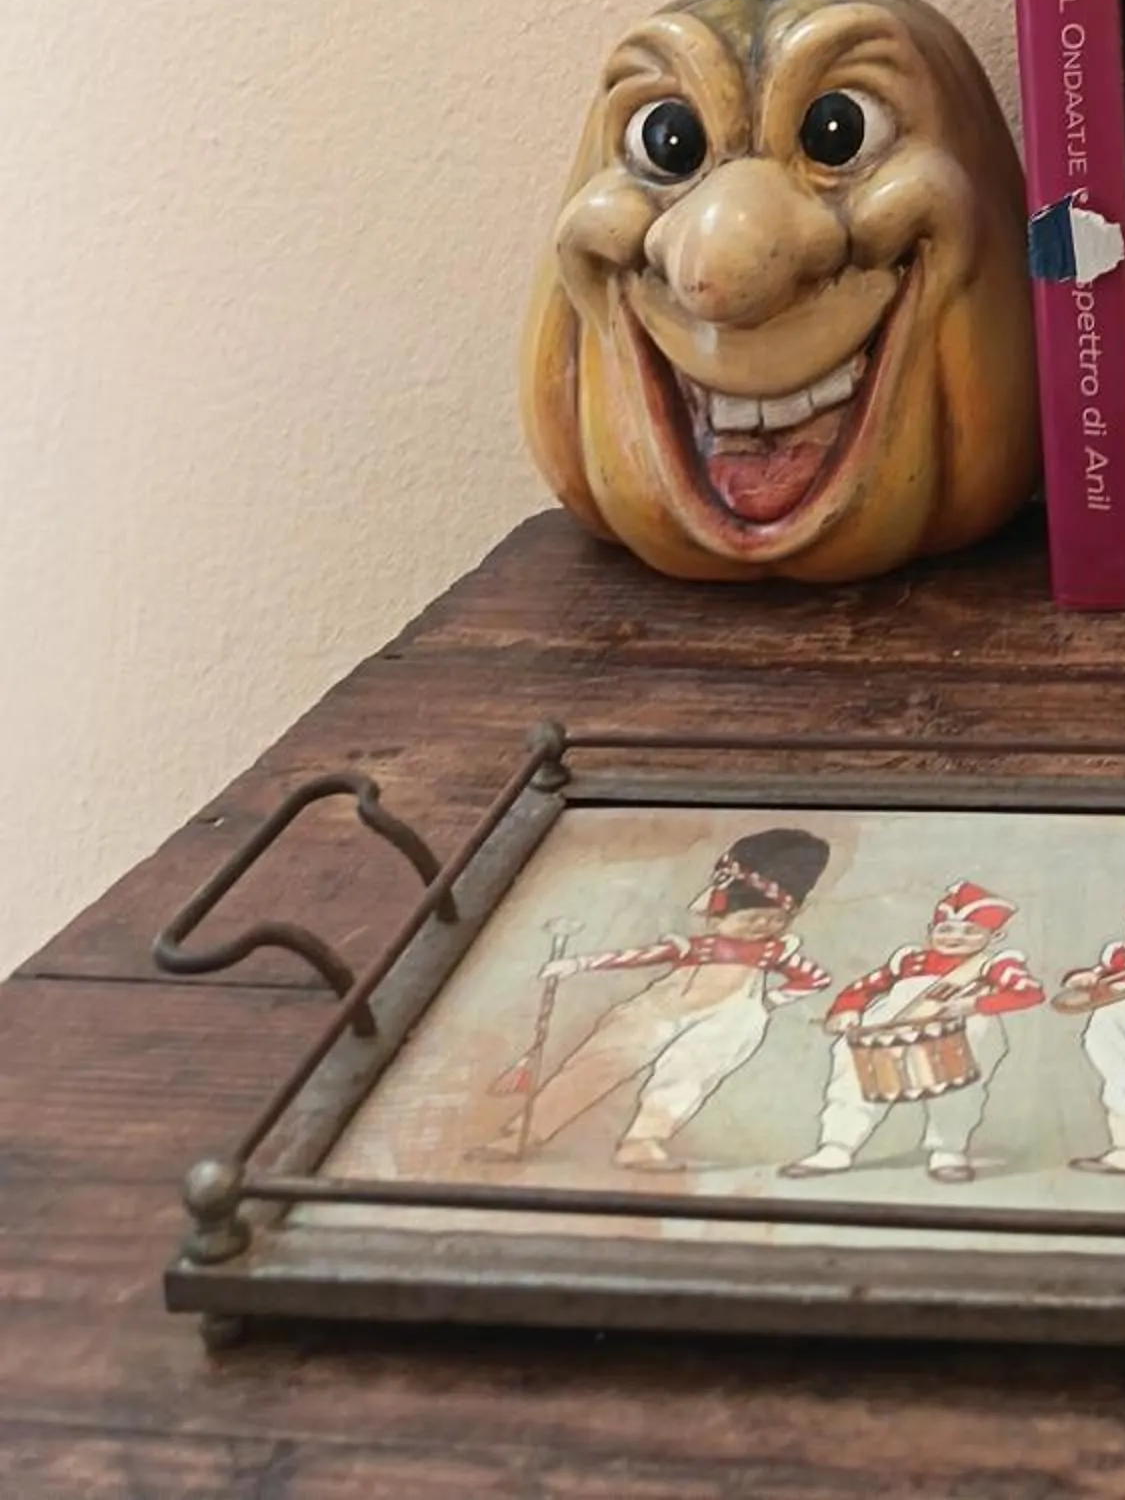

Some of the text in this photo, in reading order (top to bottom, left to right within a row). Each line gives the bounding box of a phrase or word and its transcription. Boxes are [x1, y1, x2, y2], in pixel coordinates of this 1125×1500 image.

[1061, 25, 1087, 176] ONDAATJE
[1081, 408, 1106, 435] di
[1084, 449, 1111, 511] Anil
